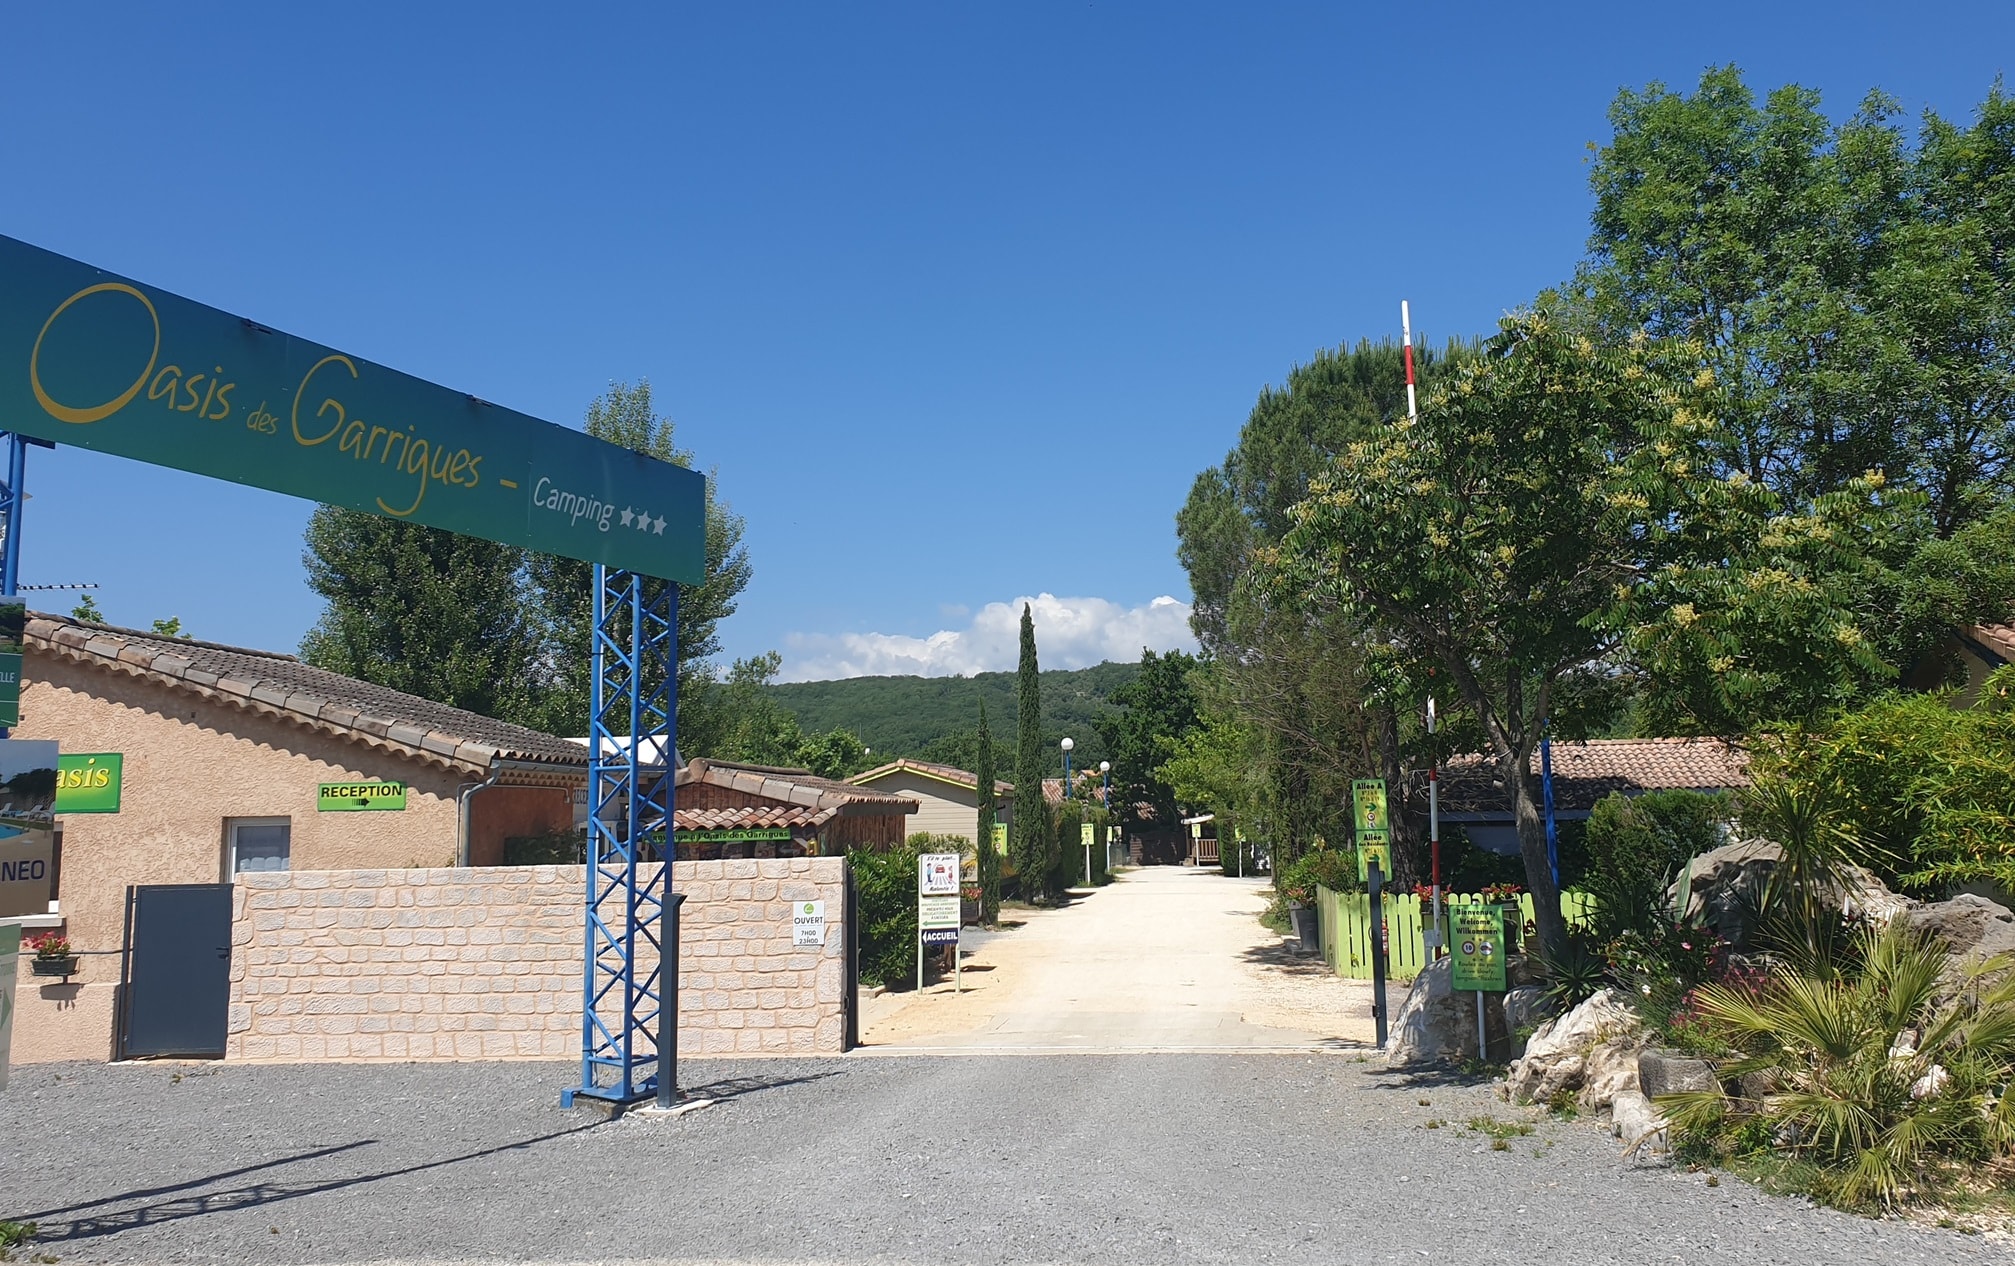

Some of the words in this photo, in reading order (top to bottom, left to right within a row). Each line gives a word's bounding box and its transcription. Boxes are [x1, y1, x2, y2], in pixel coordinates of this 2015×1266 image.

[30, 282, 236, 424] Oasis
[246, 400, 280, 437] des
[291, 354, 483, 516] Garrigues
[533, 476, 615, 533] Camping
[56, 757, 110, 789] asis
[321, 785, 403, 798] RECEPTION
[2, 859, 45, 882] NEO
[1456, 908, 1496, 917] Bienvenue,
[794, 916, 823, 925] OUVERT
[927, 931, 958, 941] ACCUEIL
[1456, 927, 1498, 935] Willkommen
